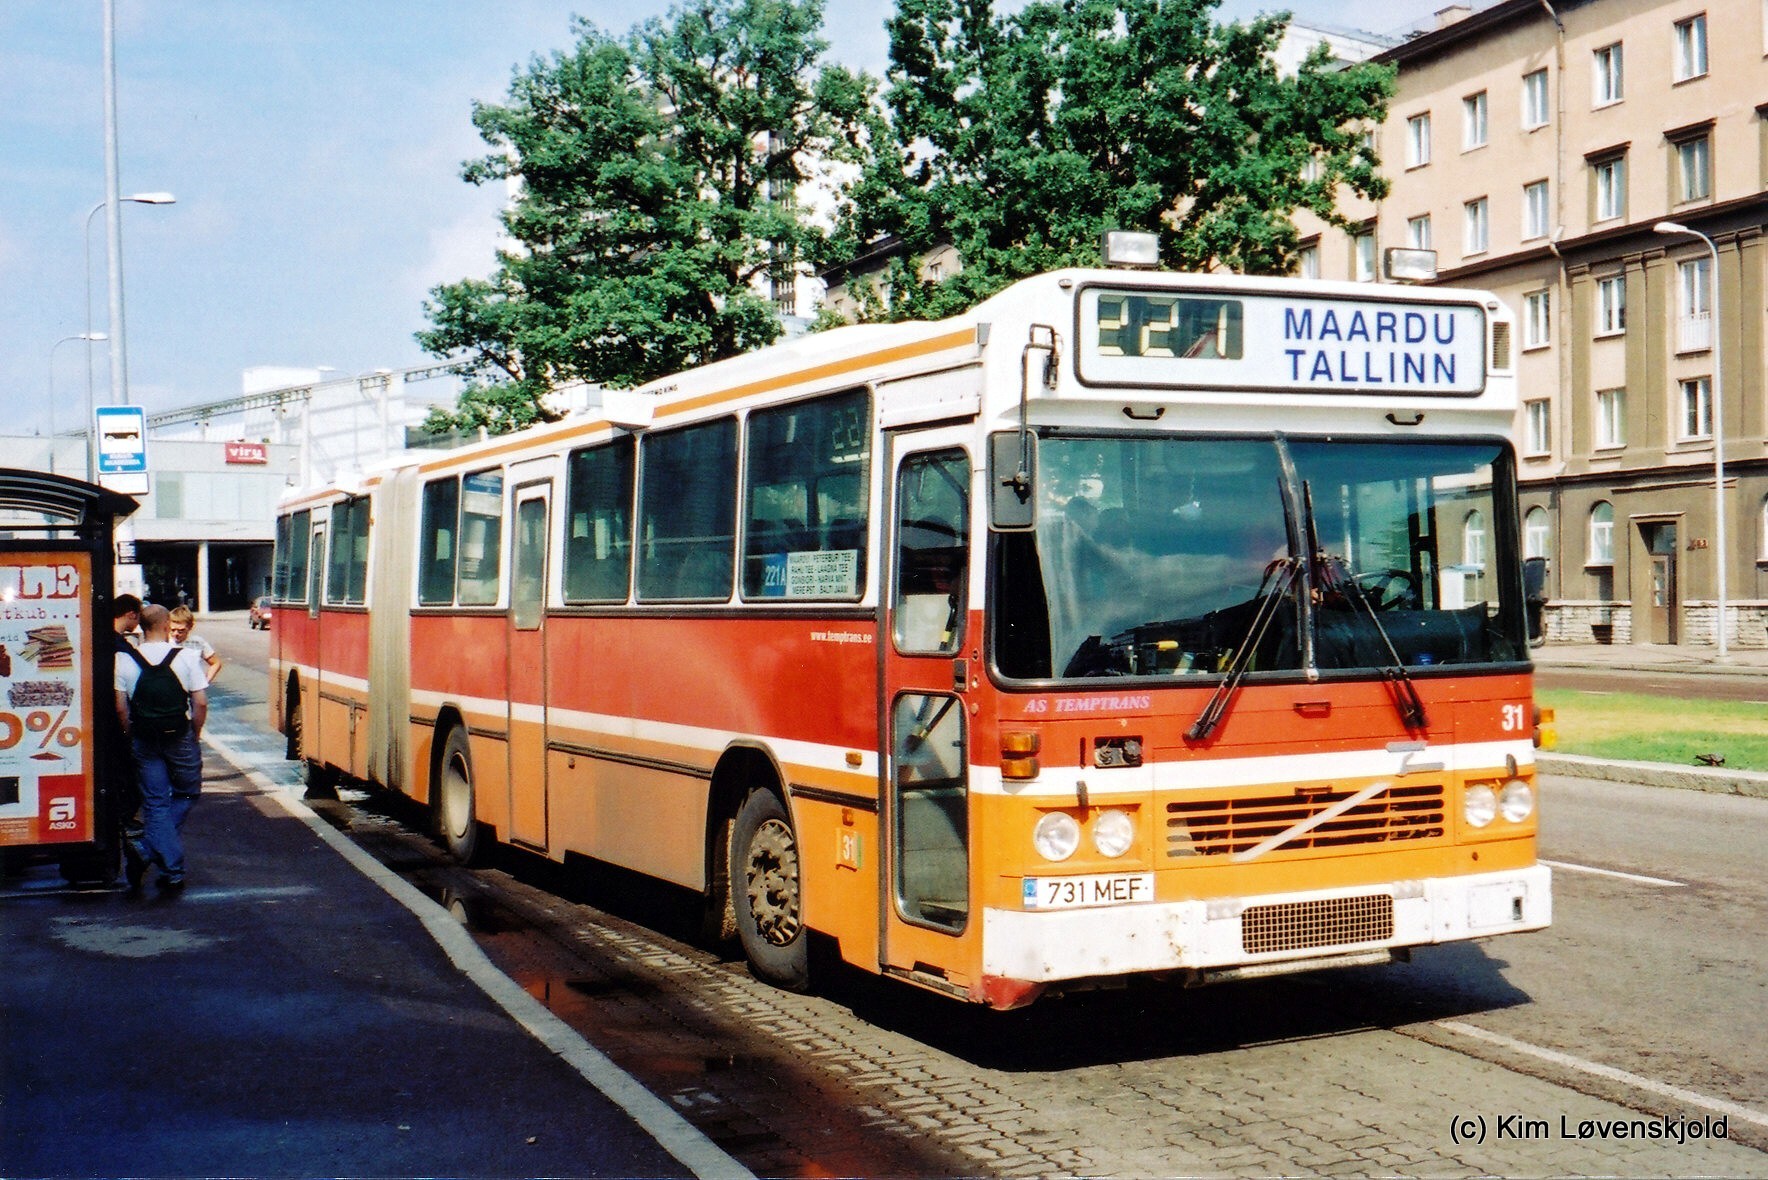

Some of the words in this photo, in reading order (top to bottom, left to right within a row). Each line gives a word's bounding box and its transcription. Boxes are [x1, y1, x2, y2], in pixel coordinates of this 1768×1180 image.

[1284, 307, 1456, 345] MAARDU
[1285, 348, 1457, 385] TALLINN
[0, 564, 80, 600] LE
[810, 630, 873, 645] www.temptrans.ee
[1023, 699, 1048, 713] AS
[1055, 696, 1151, 712] TEMPTRANS
[1501, 703, 1524, 731] 31
[49, 820, 77, 831] ASKO
[842, 834, 856, 861] 31
[1048, 881, 1085, 904] 731
[1094, 878, 1143, 902] MEF
